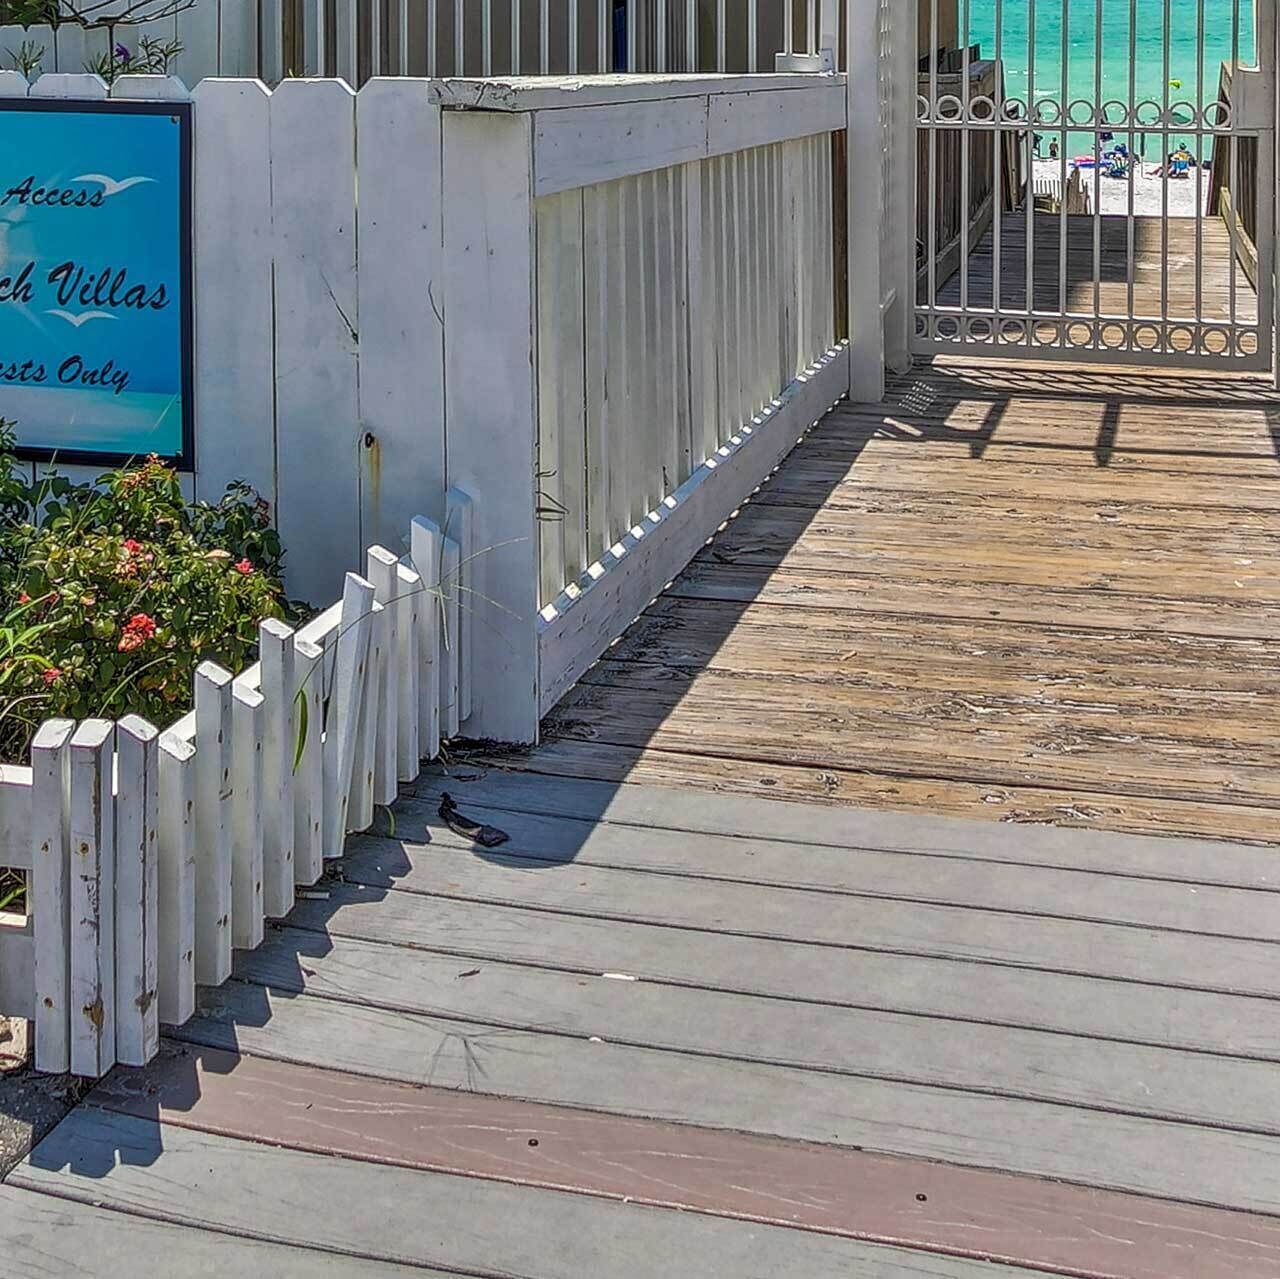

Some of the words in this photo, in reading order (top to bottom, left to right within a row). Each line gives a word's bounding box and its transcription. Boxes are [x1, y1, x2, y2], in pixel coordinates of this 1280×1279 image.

[2, 176, 105, 208] Access
[47, 262, 171, 311] Villas
[57, 355, 131, 395] Only
